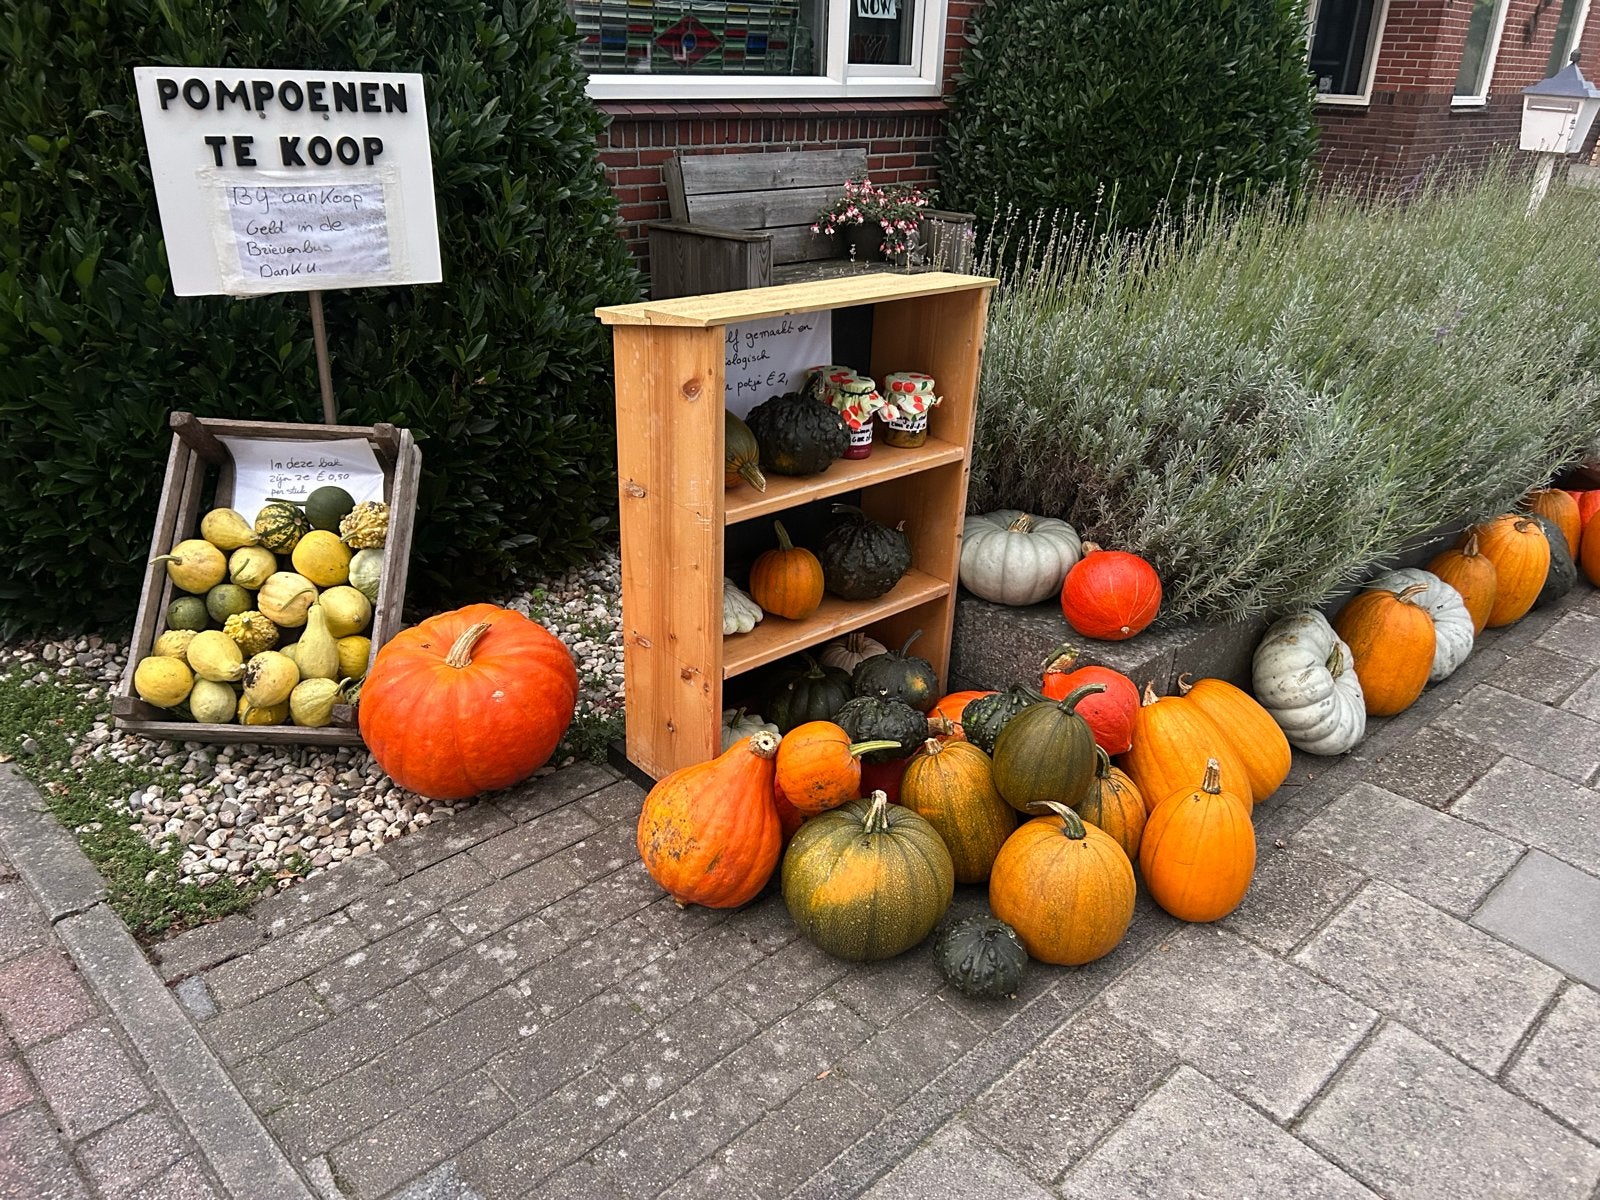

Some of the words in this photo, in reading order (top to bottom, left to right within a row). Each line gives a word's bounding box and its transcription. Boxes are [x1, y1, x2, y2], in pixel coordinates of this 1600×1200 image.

[157, 78, 408, 113] POMPOENEN
[204, 136, 257, 167] TE
[279, 136, 384, 167] KOOP
[246, 220, 287, 236] Geld
[298, 222, 314, 232] in
[319, 216, 346, 232] de
[745, 320, 795, 349] gemaakt
[270, 458, 283, 471] In
[286, 457, 315, 470] deze
[318, 457, 344, 469] bak
